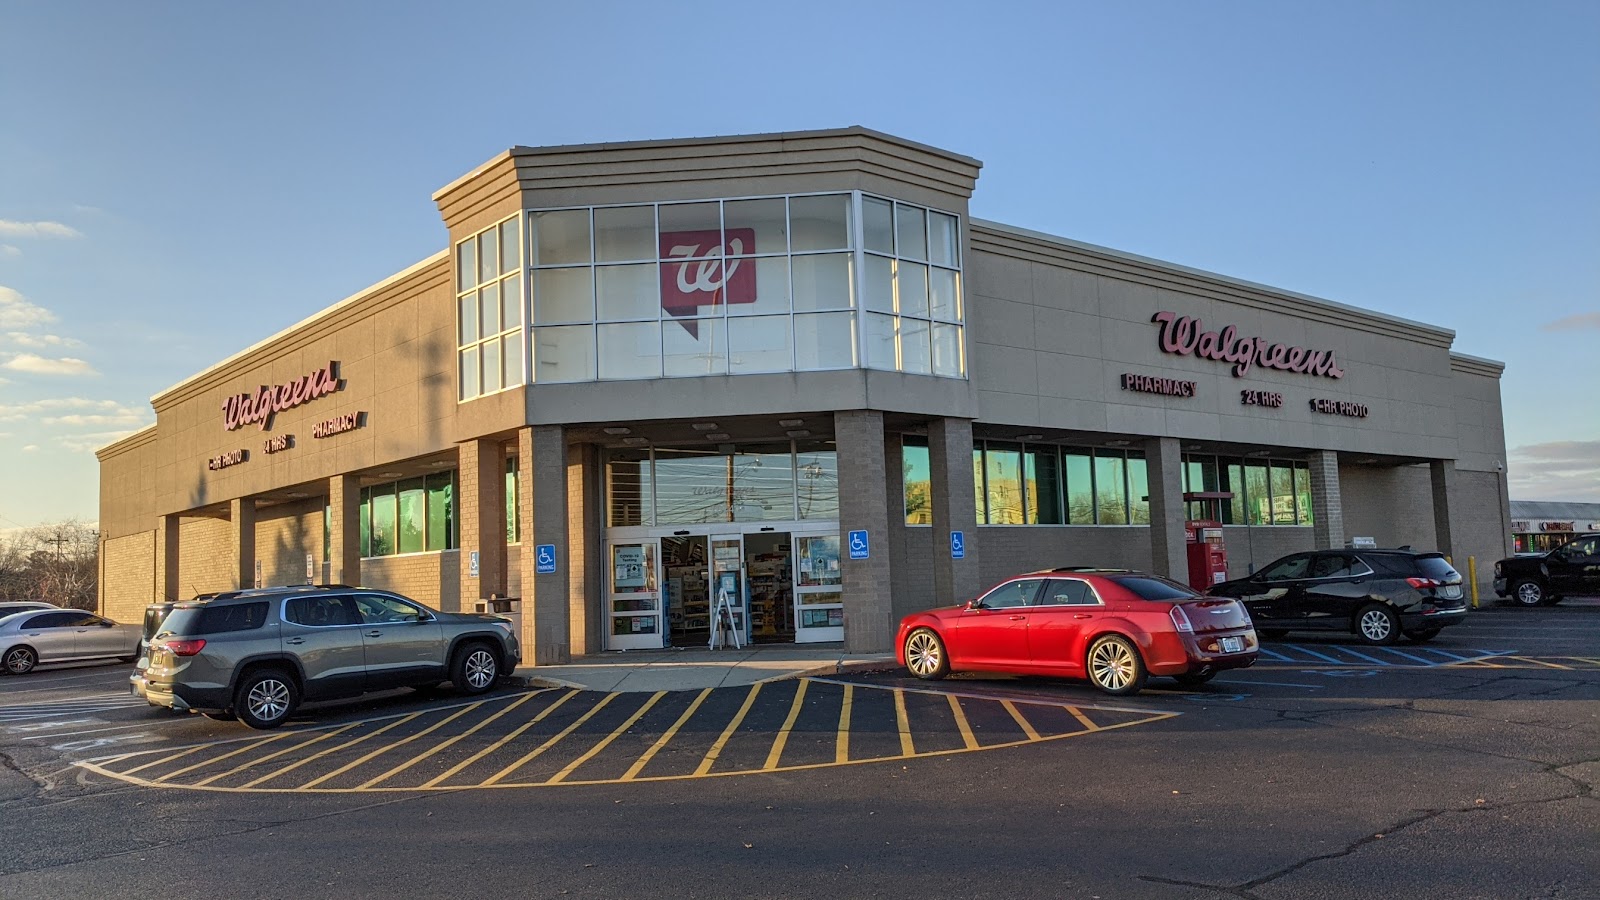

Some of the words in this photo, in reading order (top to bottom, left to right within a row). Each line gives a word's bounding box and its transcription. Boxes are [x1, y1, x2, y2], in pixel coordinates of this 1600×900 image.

[1152, 311, 1345, 379] Walgreens
[222, 360, 340, 431] Walgreens
[1123, 373, 1197, 397] PHARMACY
[1244, 390, 1258, 405] 24
[1261, 391, 1283, 407] HRS
[1313, 399, 1337, 413] 1-HR
[1340, 401, 1369, 417] PHOTO
[312, 411, 359, 438] PHARMACY
[271, 434, 287, 451] HRS
[222, 449, 242, 466] PHOTO
